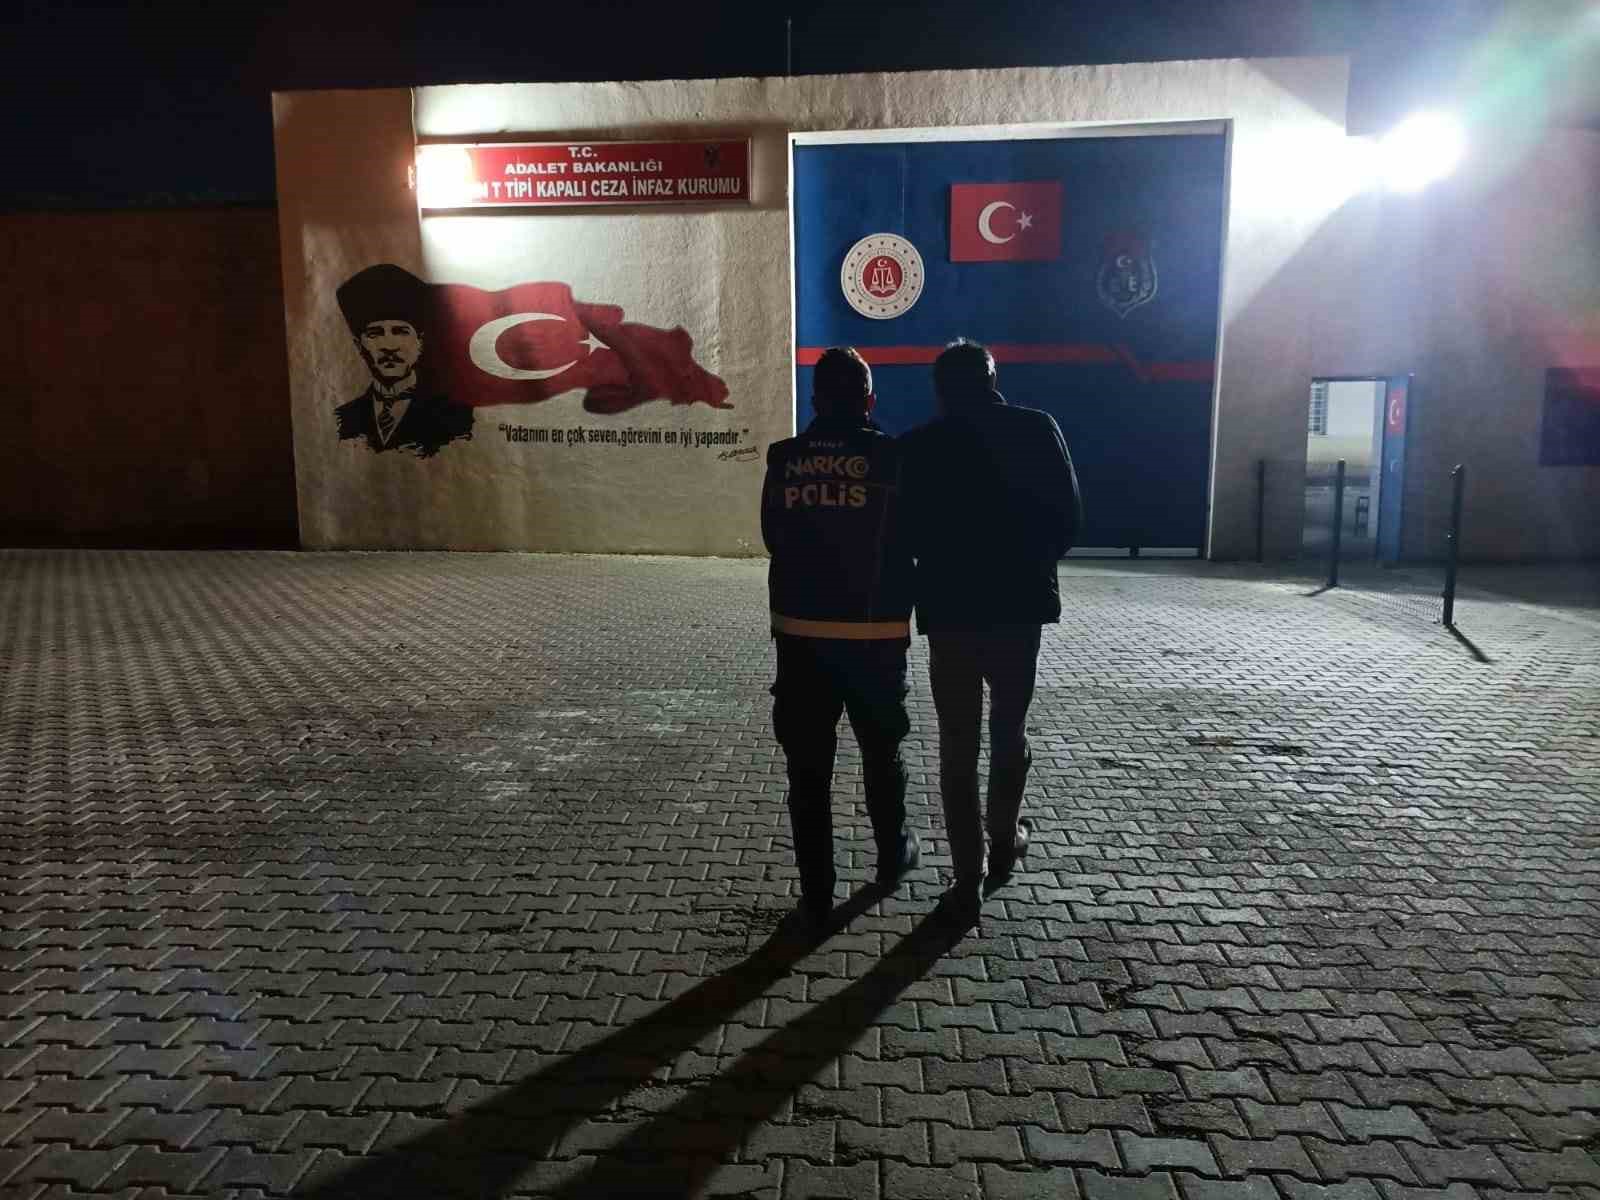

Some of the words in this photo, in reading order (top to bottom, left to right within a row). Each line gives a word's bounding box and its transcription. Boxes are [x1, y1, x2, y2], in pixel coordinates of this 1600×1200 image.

[568, 146, 598, 158] T.C.
[505, 162, 568, 175] ADALET
[573, 159, 663, 173] BAKANLIĞI
[491, 182, 502, 198] T
[505, 177, 532, 198] TİPİ
[536, 180, 586, 197] KAPALI
[590, 179, 628, 196] CEZA
[632, 176, 674, 195] İNFAZ
[678, 176, 741, 195] KURUMU
[551, 428, 564, 443] en
[567, 426, 585, 447] çok
[664, 431, 677, 444] en
[680, 428, 692, 448] iyi
